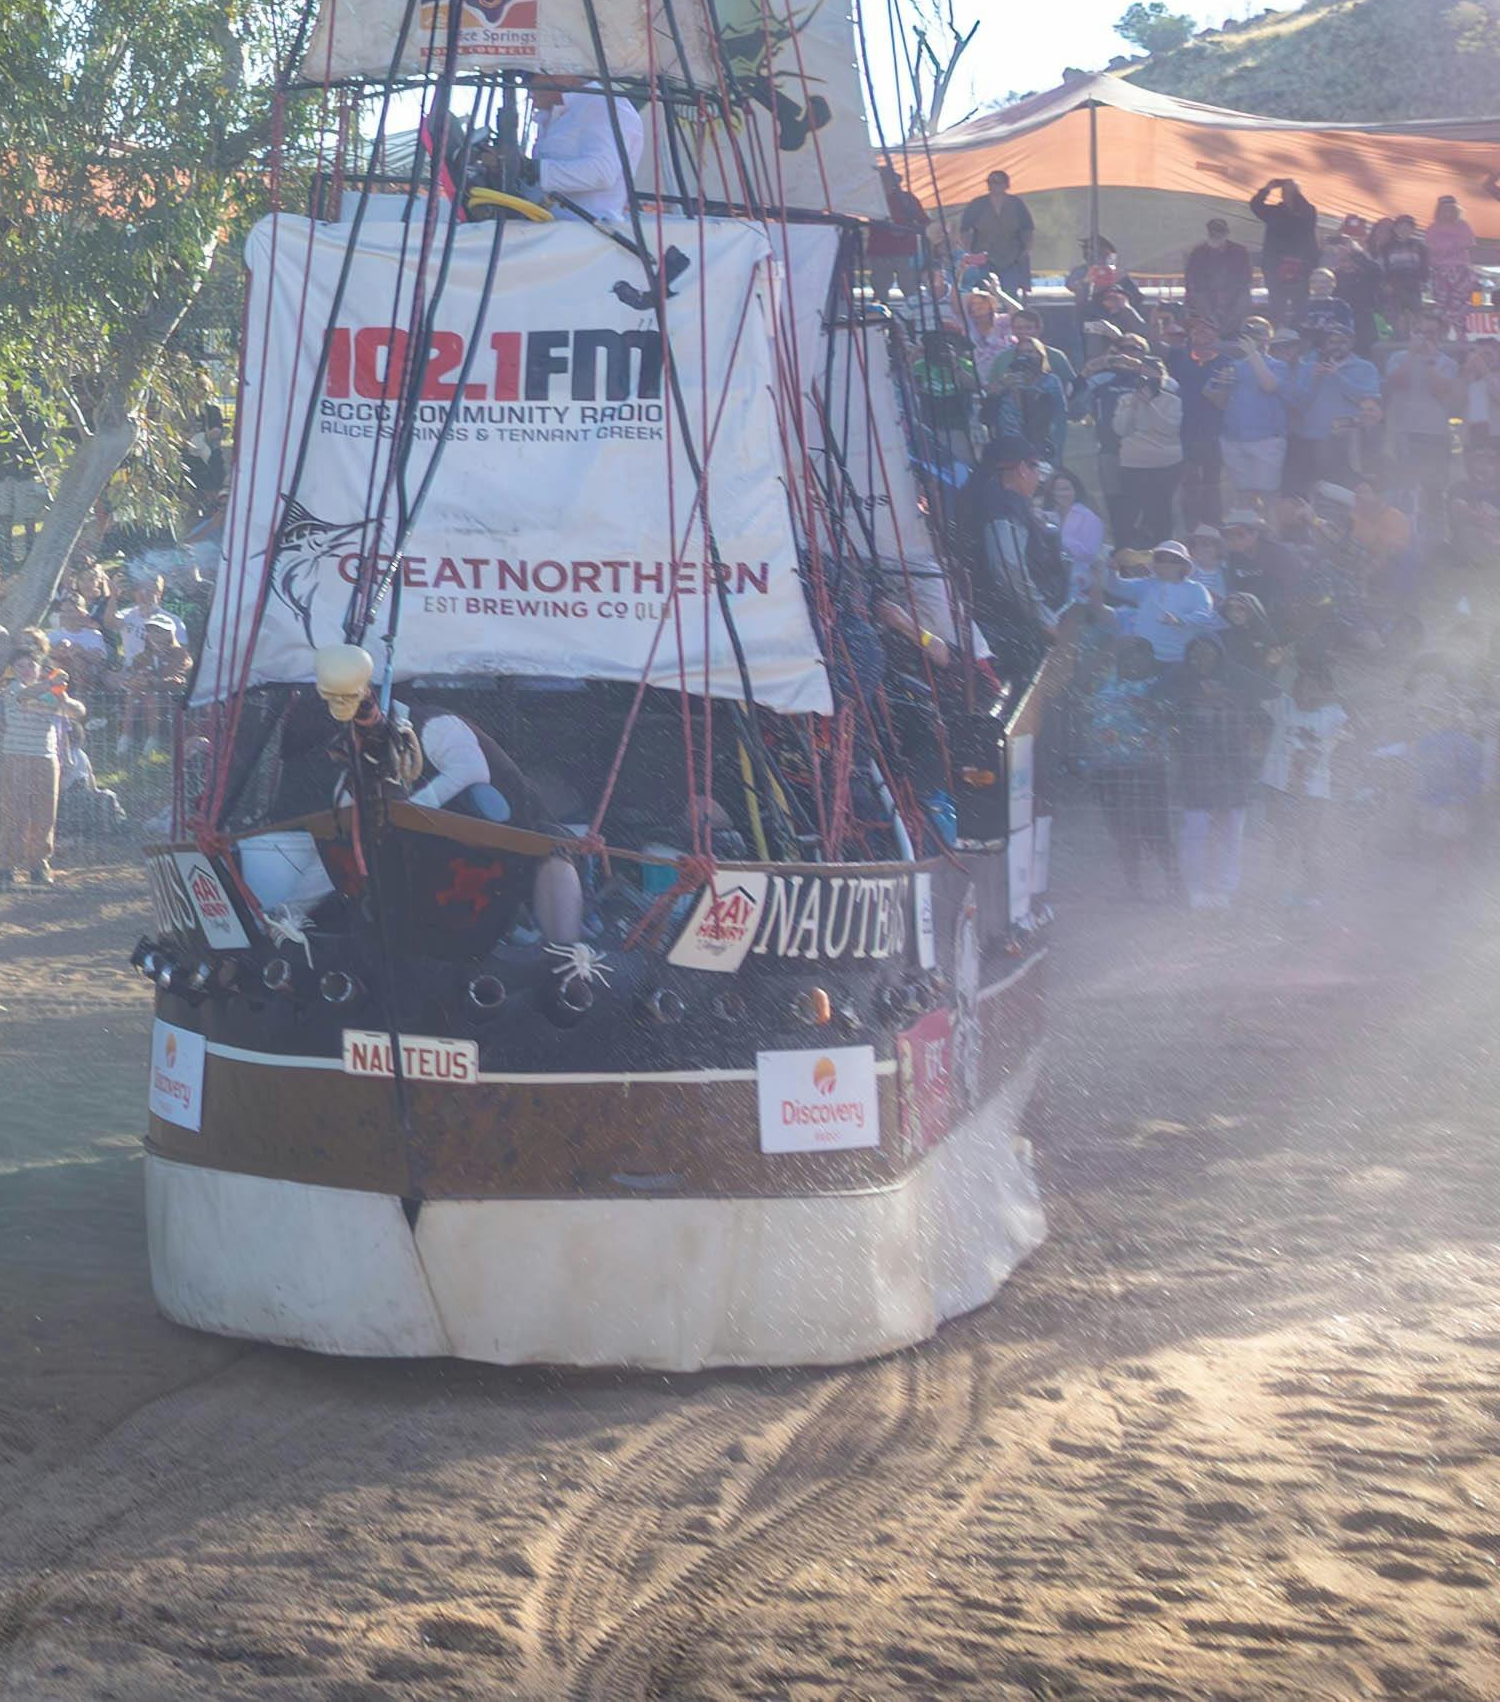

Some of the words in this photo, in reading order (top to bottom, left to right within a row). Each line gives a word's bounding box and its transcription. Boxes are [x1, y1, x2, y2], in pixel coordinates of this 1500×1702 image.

[483, 28, 537, 45] Springs
[323, 326, 665, 402] 102.1FM
[320, 400, 391, 422] 8CCC
[581, 403, 663, 424] RADIO
[320, 420, 373, 440] ALICE
[379, 424, 468, 442] SRINGS
[499, 427, 590, 443] TENNANT
[497, 559, 770, 595] NORTHERN
[424, 597, 459, 615] EST
[466, 597, 587, 618] BREWING
[351, 1042, 468, 1079] NAUTEUS
[781, 1100, 866, 1128] Discovery
